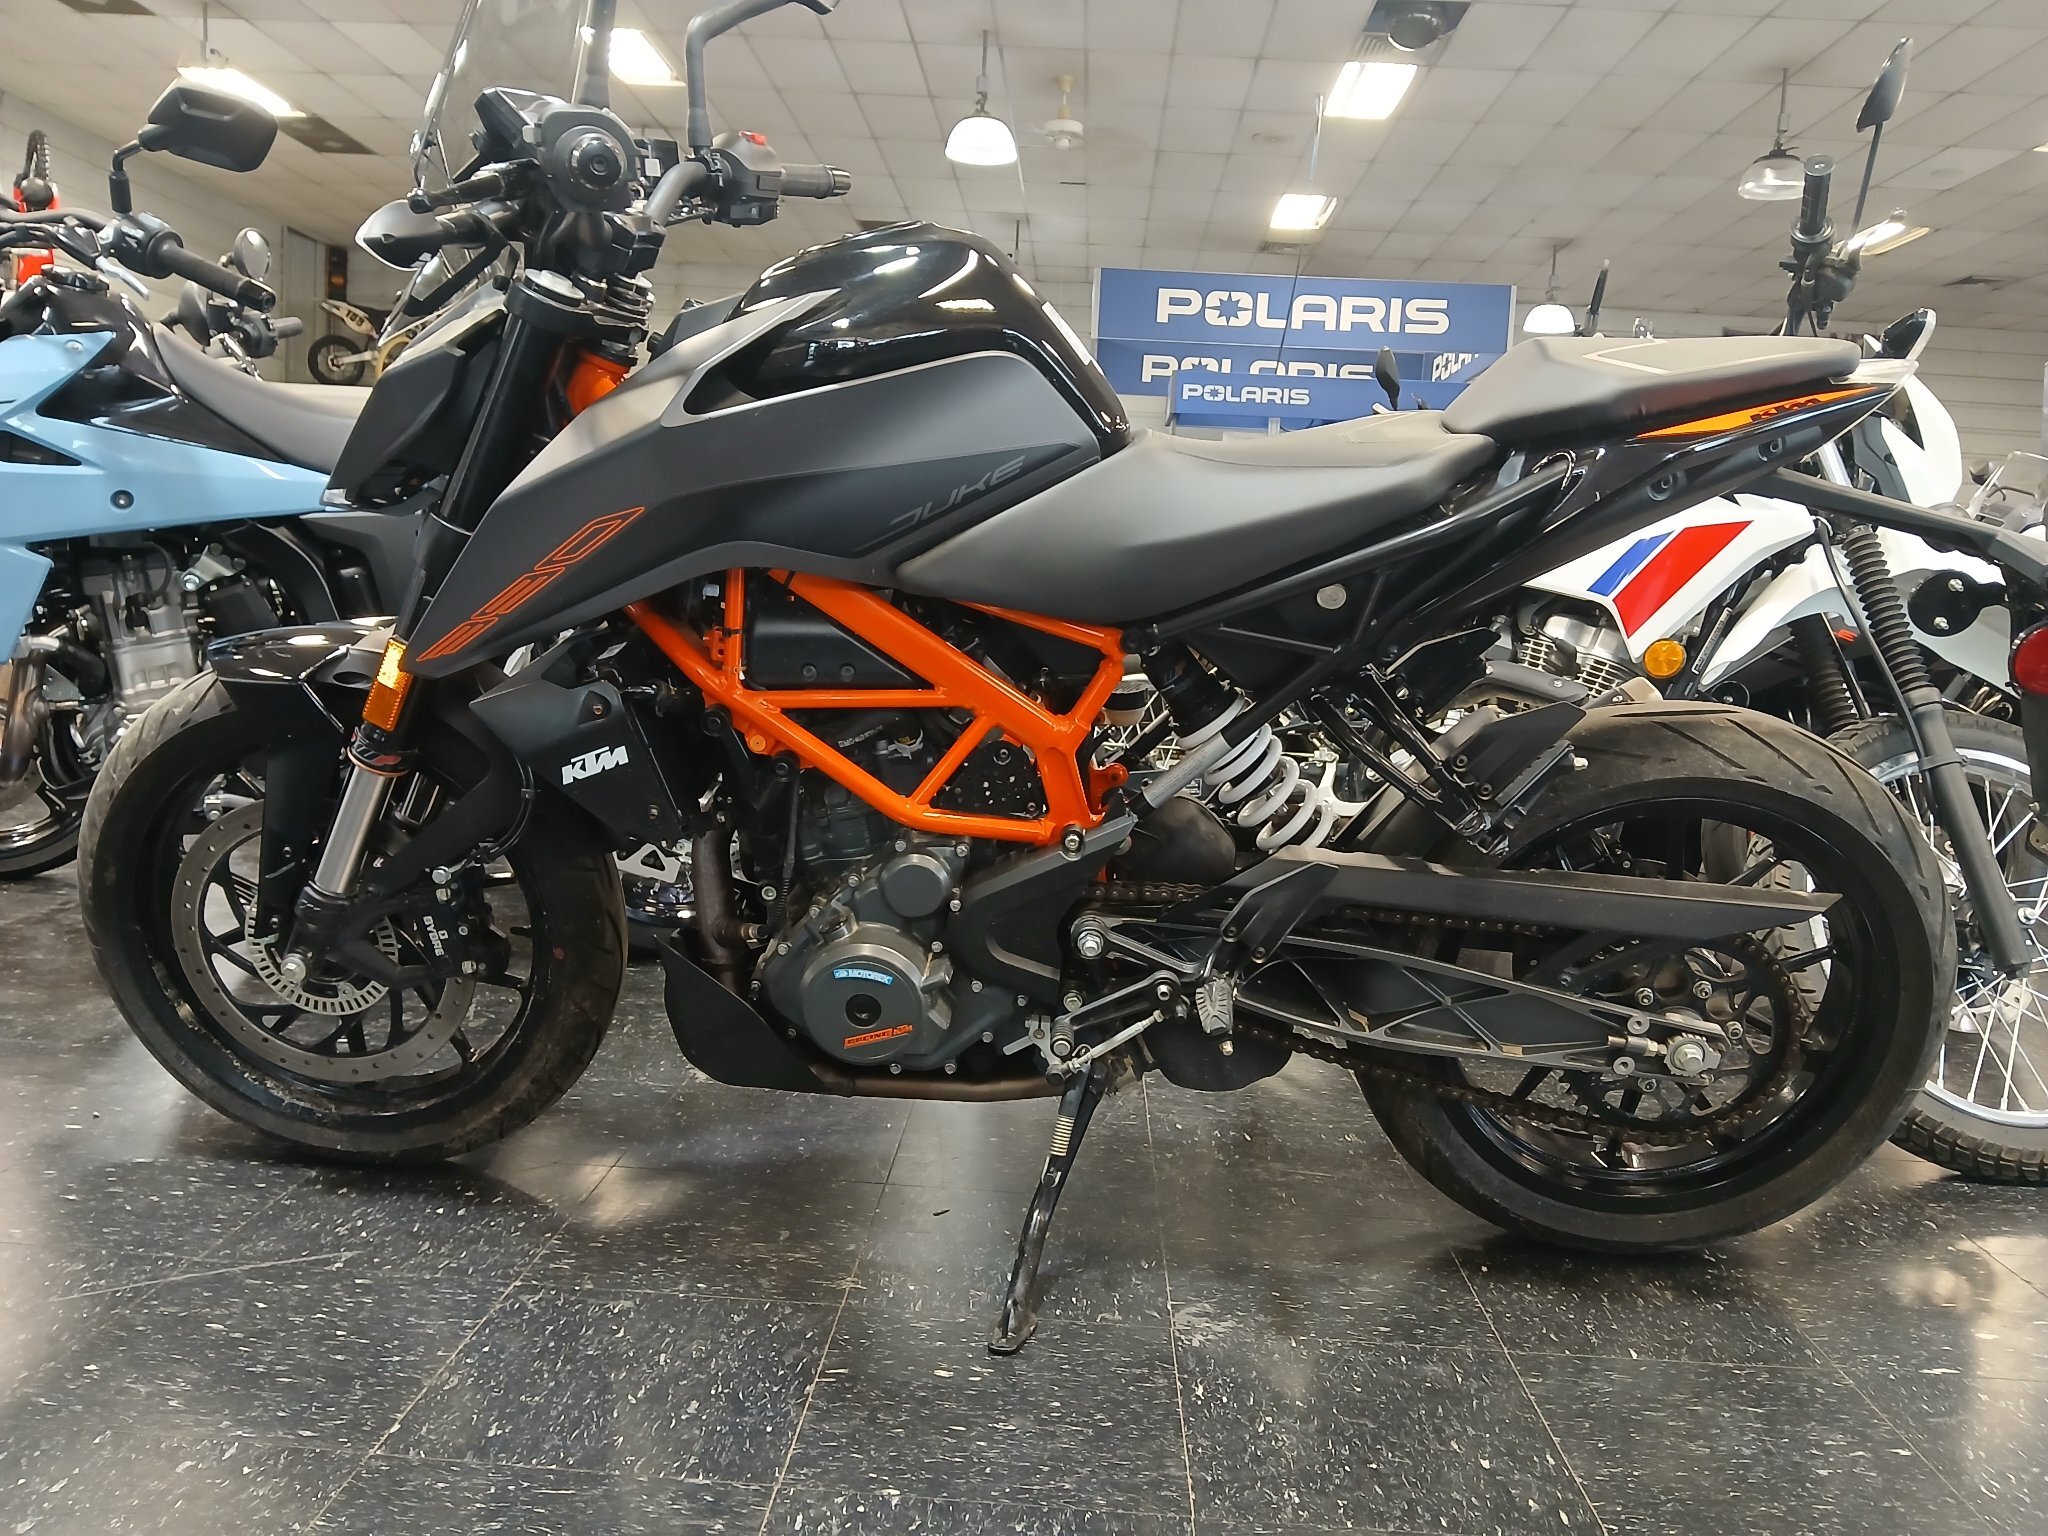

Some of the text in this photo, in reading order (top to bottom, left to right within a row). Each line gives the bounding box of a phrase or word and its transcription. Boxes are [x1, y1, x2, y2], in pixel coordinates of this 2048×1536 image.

[1156, 287, 1450, 335] POLARIS
[1431, 352, 1479, 382] POLA
[1182, 383, 1310, 406] POLARIS
[887, 454, 1026, 527] DUKE
[561, 745, 629, 786] KTM
